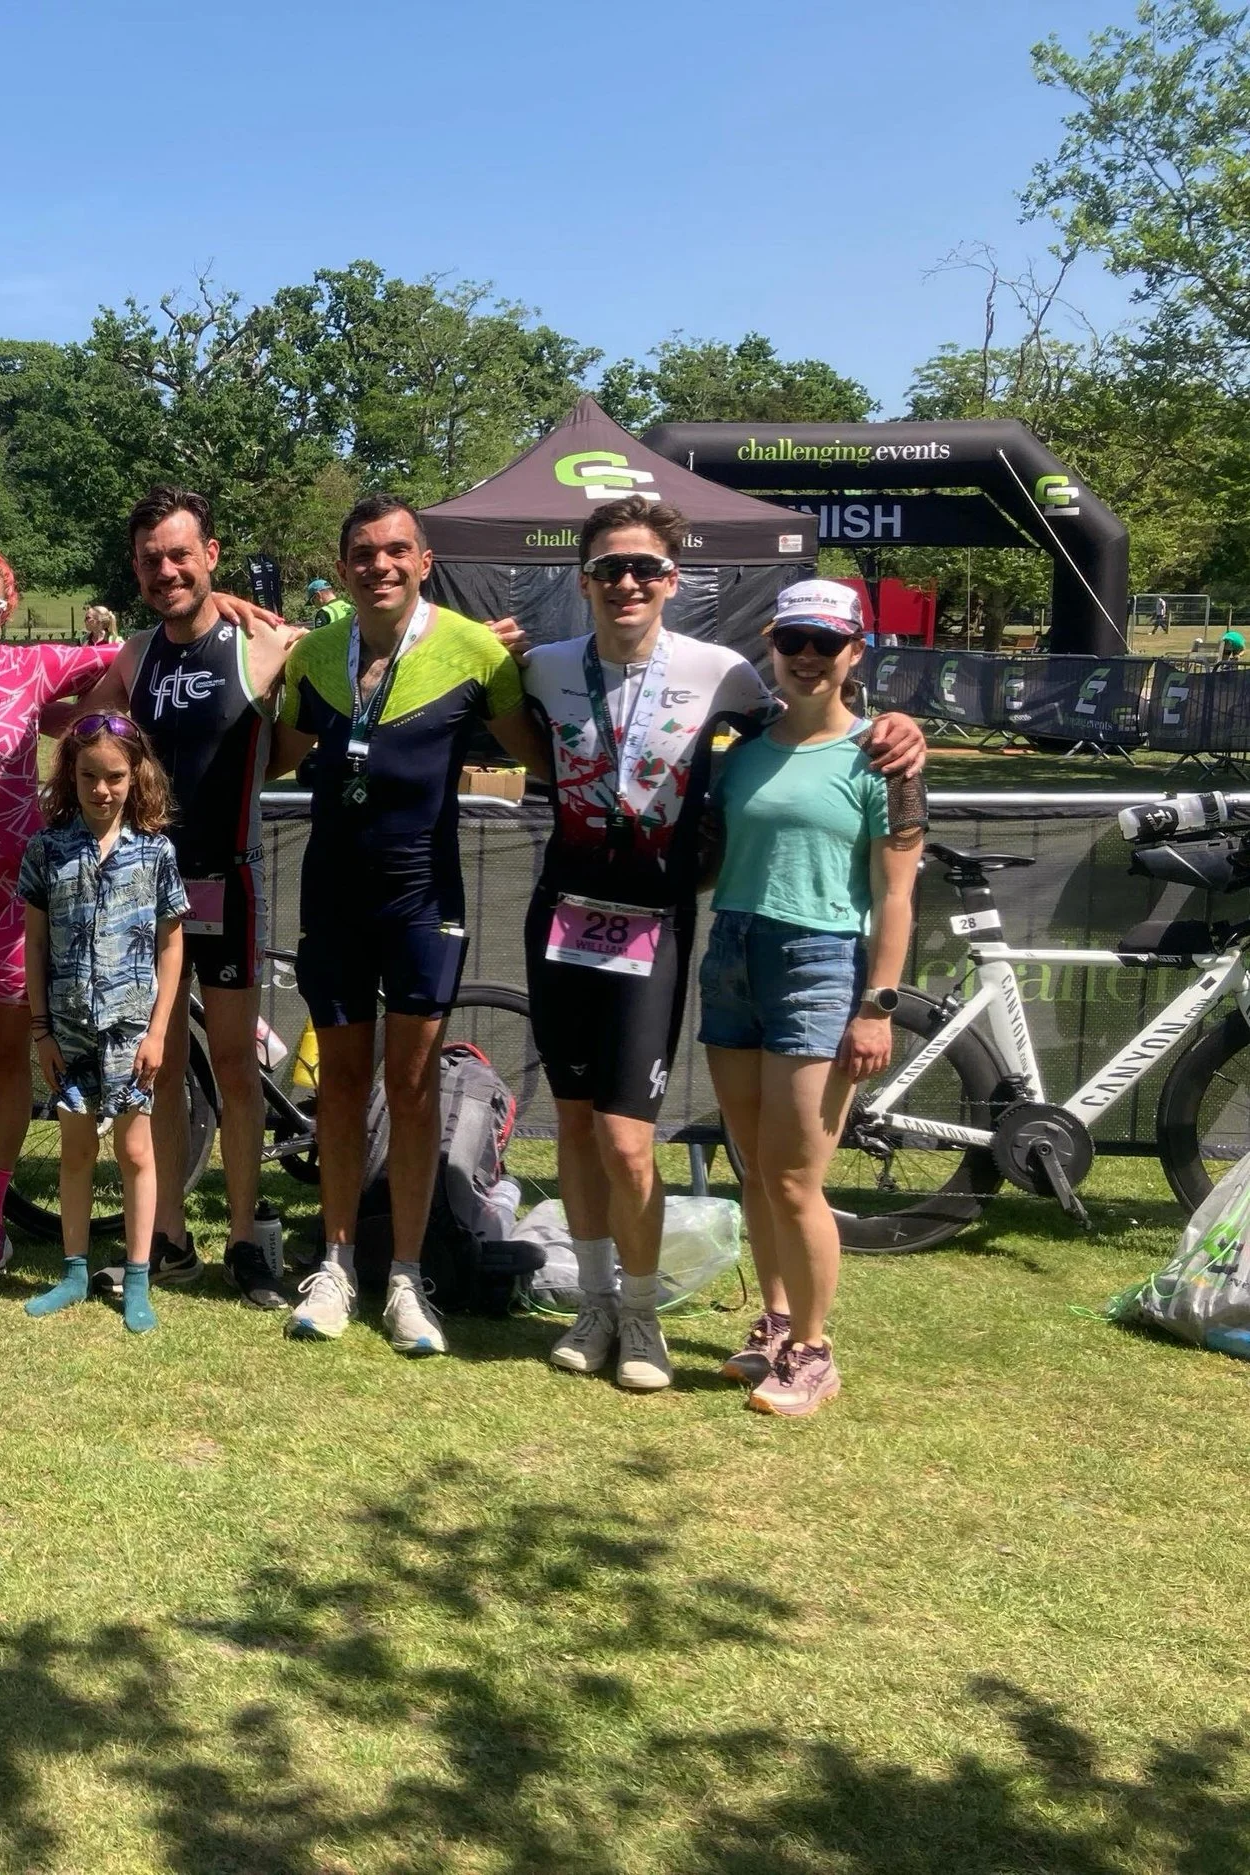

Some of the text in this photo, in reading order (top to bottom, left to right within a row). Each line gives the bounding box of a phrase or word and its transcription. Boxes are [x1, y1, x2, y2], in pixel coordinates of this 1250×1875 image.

[737, 438, 951, 469] challenging.events
[789, 504, 901, 538] NISH
[525, 528, 581, 548] challe
[582, 912, 630, 944] 28
[960, 917, 978, 931] 28
[575, 939, 629, 957] WILLIAM
